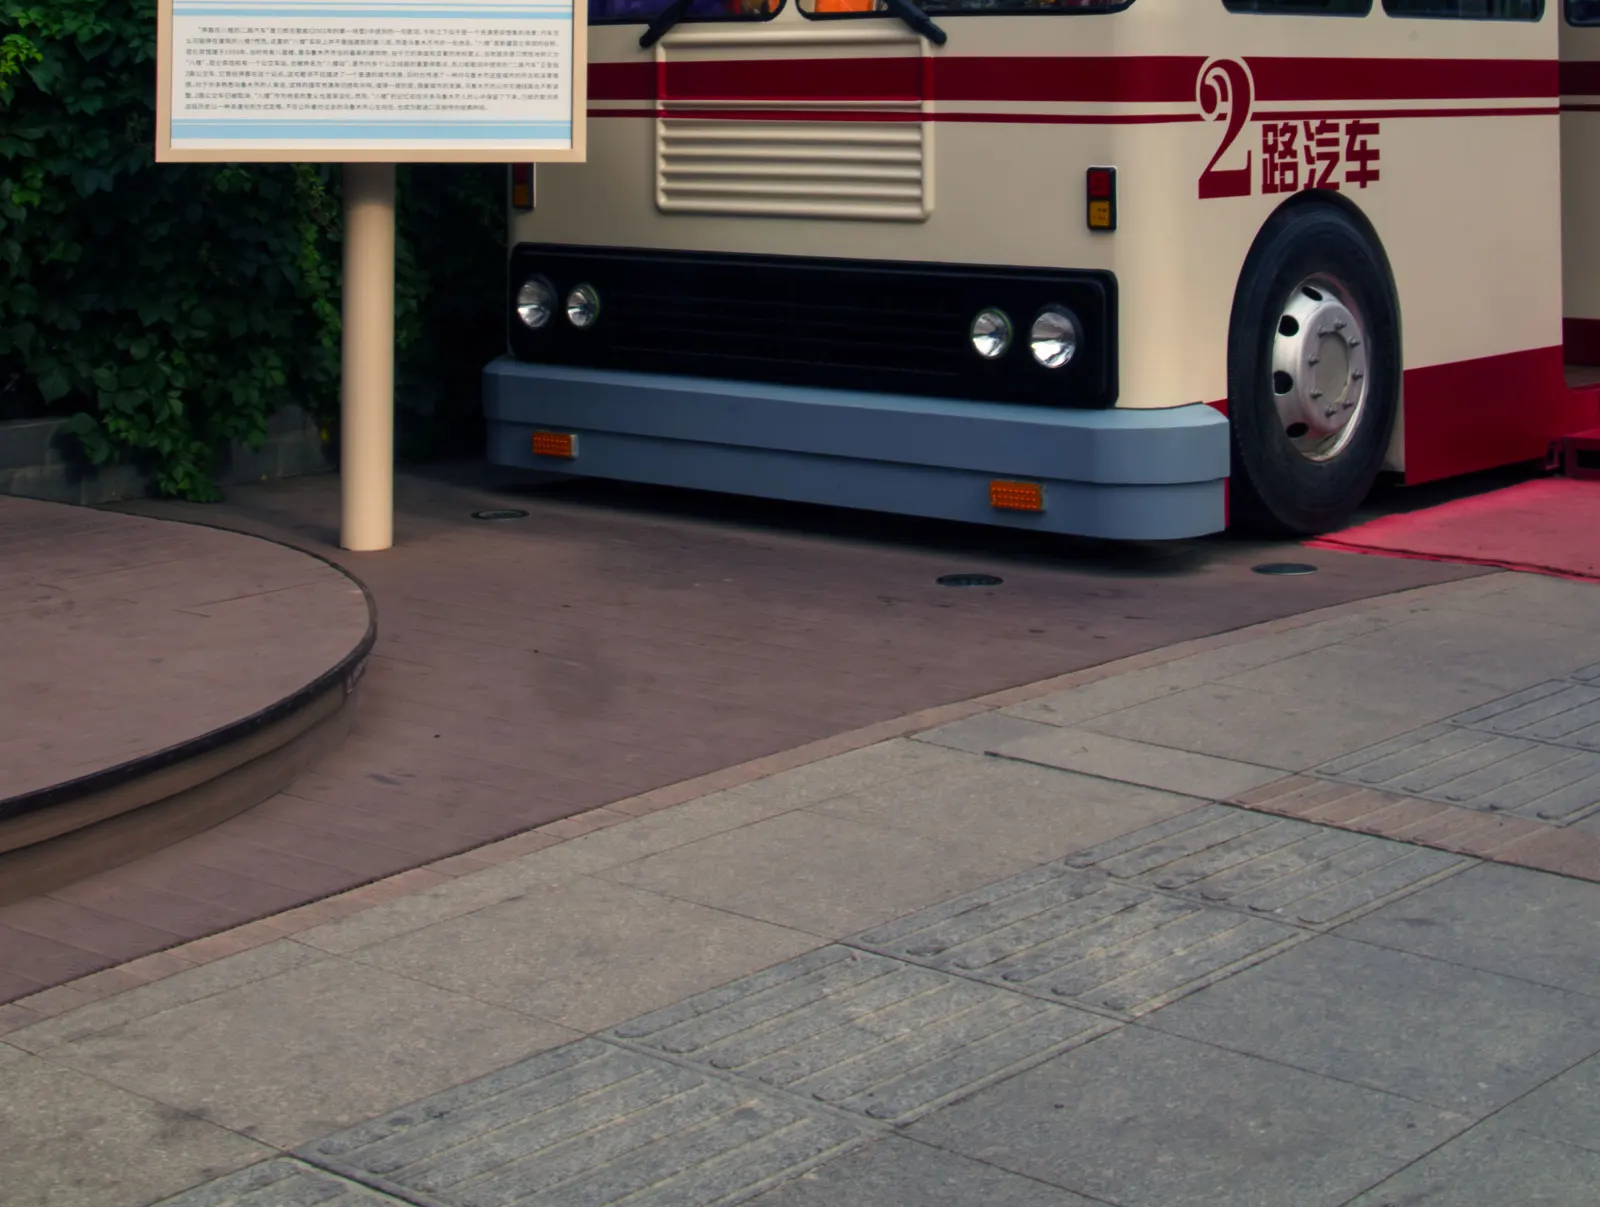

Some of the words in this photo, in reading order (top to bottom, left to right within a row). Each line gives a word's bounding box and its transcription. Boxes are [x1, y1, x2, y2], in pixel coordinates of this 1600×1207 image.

[1198, 57, 1252, 199] 2
[1262, 119, 1380, 194] 路汽车
